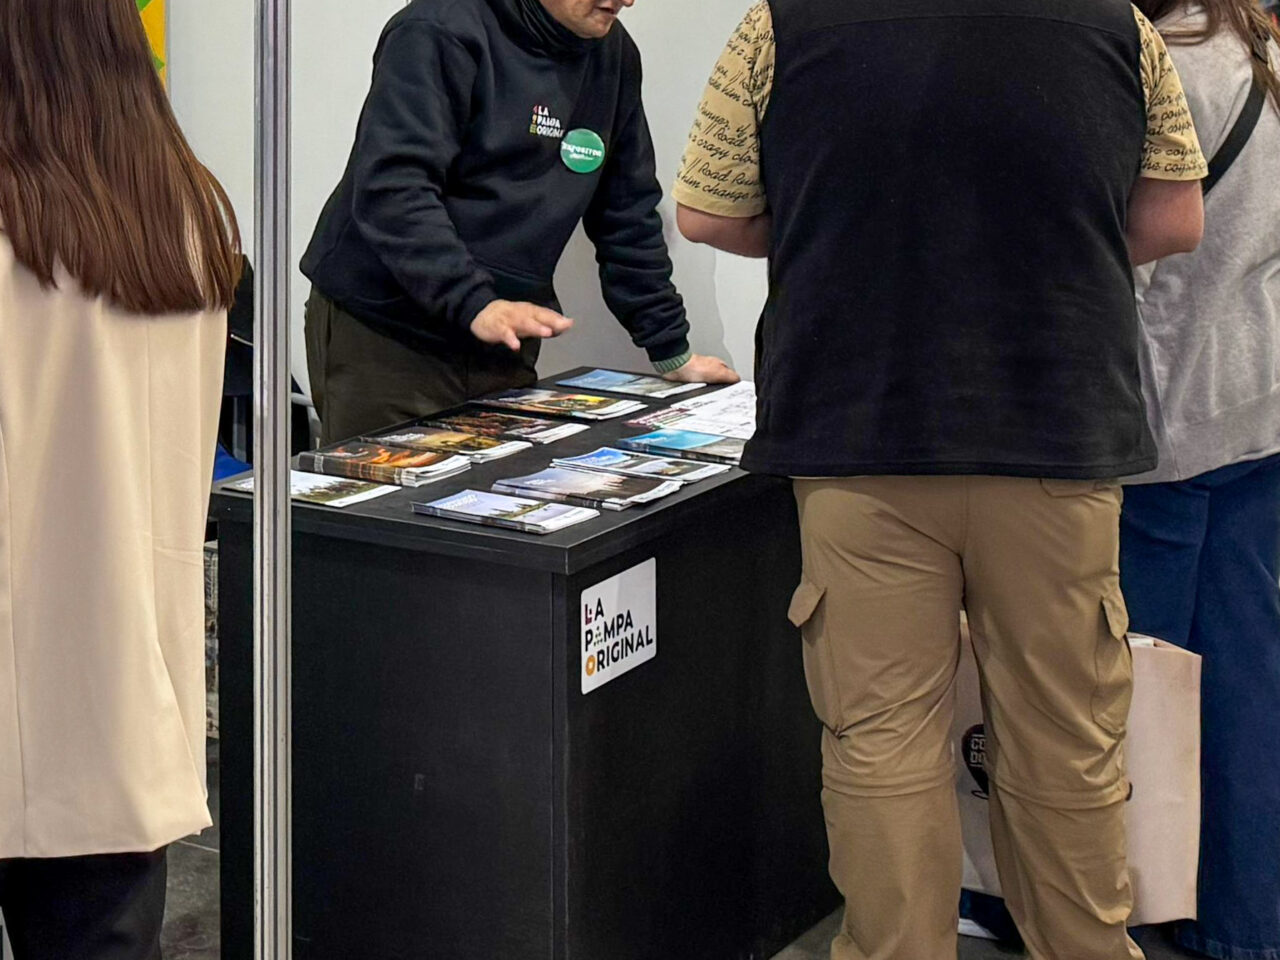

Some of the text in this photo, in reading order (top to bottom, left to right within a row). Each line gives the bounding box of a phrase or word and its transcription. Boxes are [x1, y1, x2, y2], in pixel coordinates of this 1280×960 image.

[584, 597, 605, 625] LA
[584, 609, 634, 652] PAMPA
[585, 625, 654, 677] ORIGINAL
